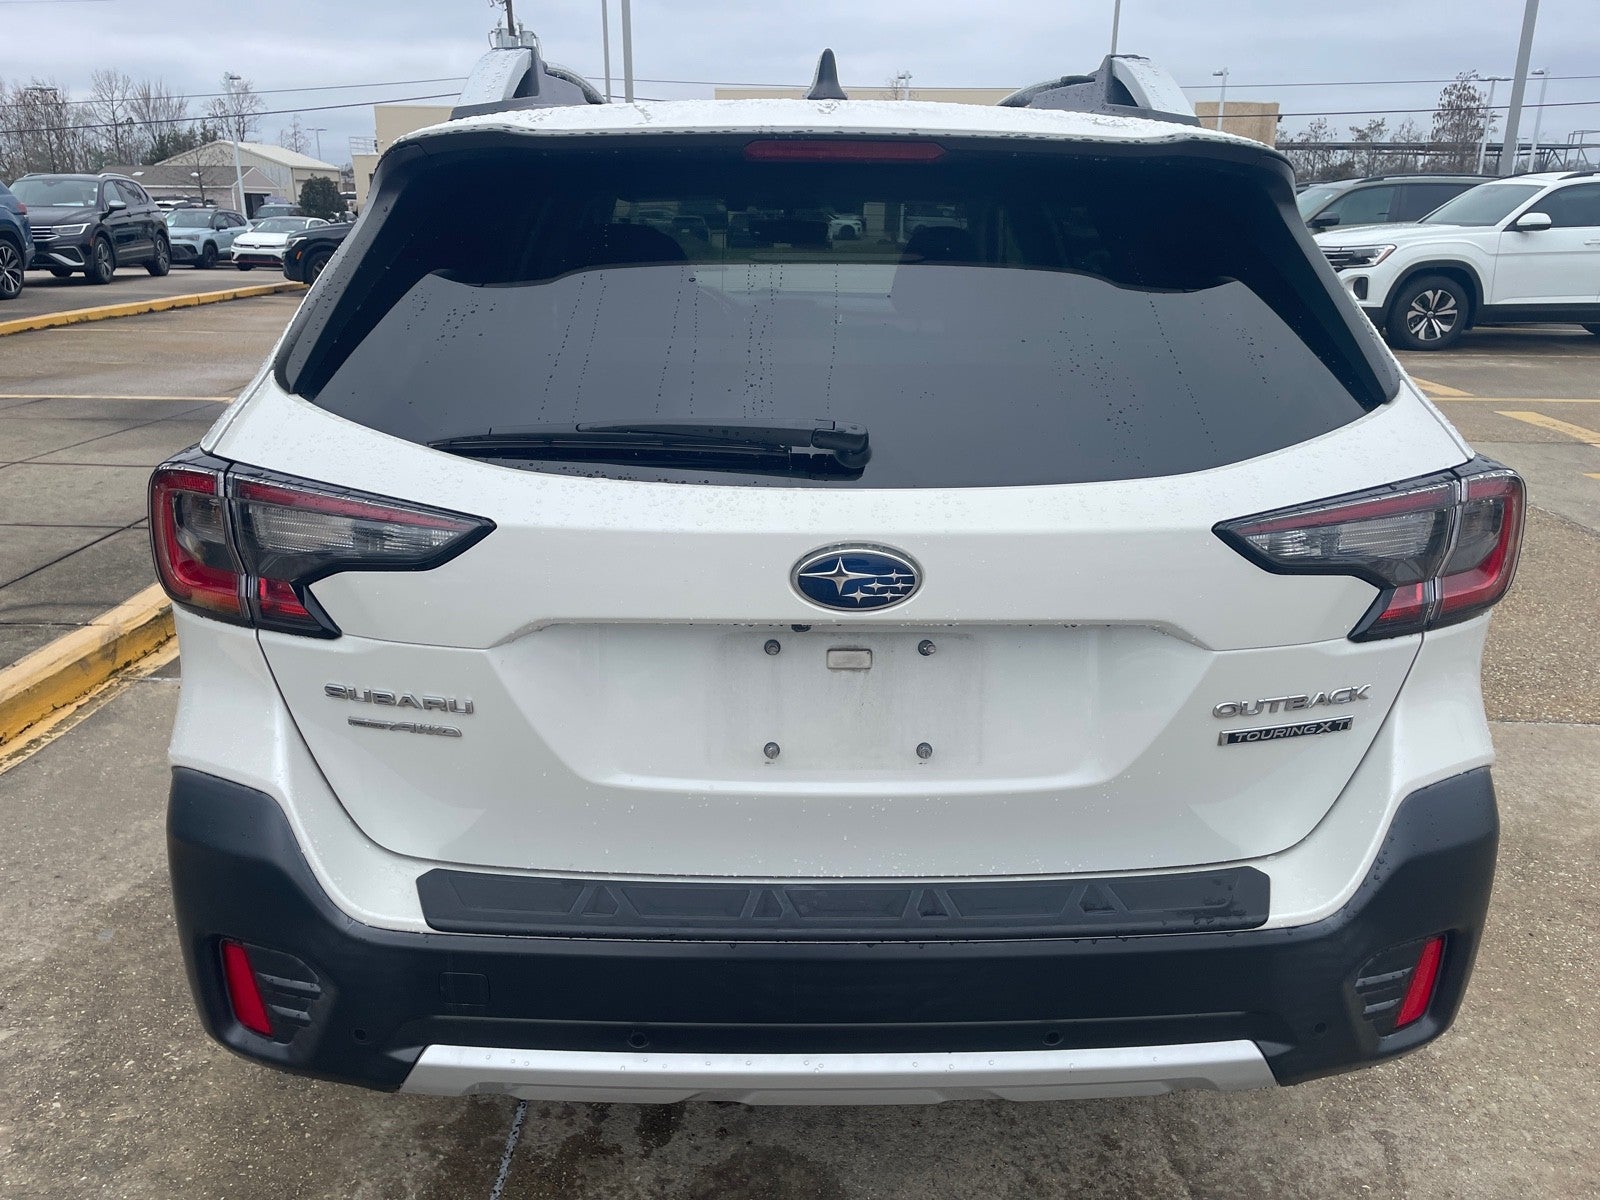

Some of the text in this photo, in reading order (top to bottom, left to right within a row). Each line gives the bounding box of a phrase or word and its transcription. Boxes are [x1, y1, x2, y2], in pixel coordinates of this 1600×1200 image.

[324, 682, 474, 714] SUBARU
[1212, 684, 1372, 718] OUTBACK
[1235, 724, 1317, 743] TOURING
